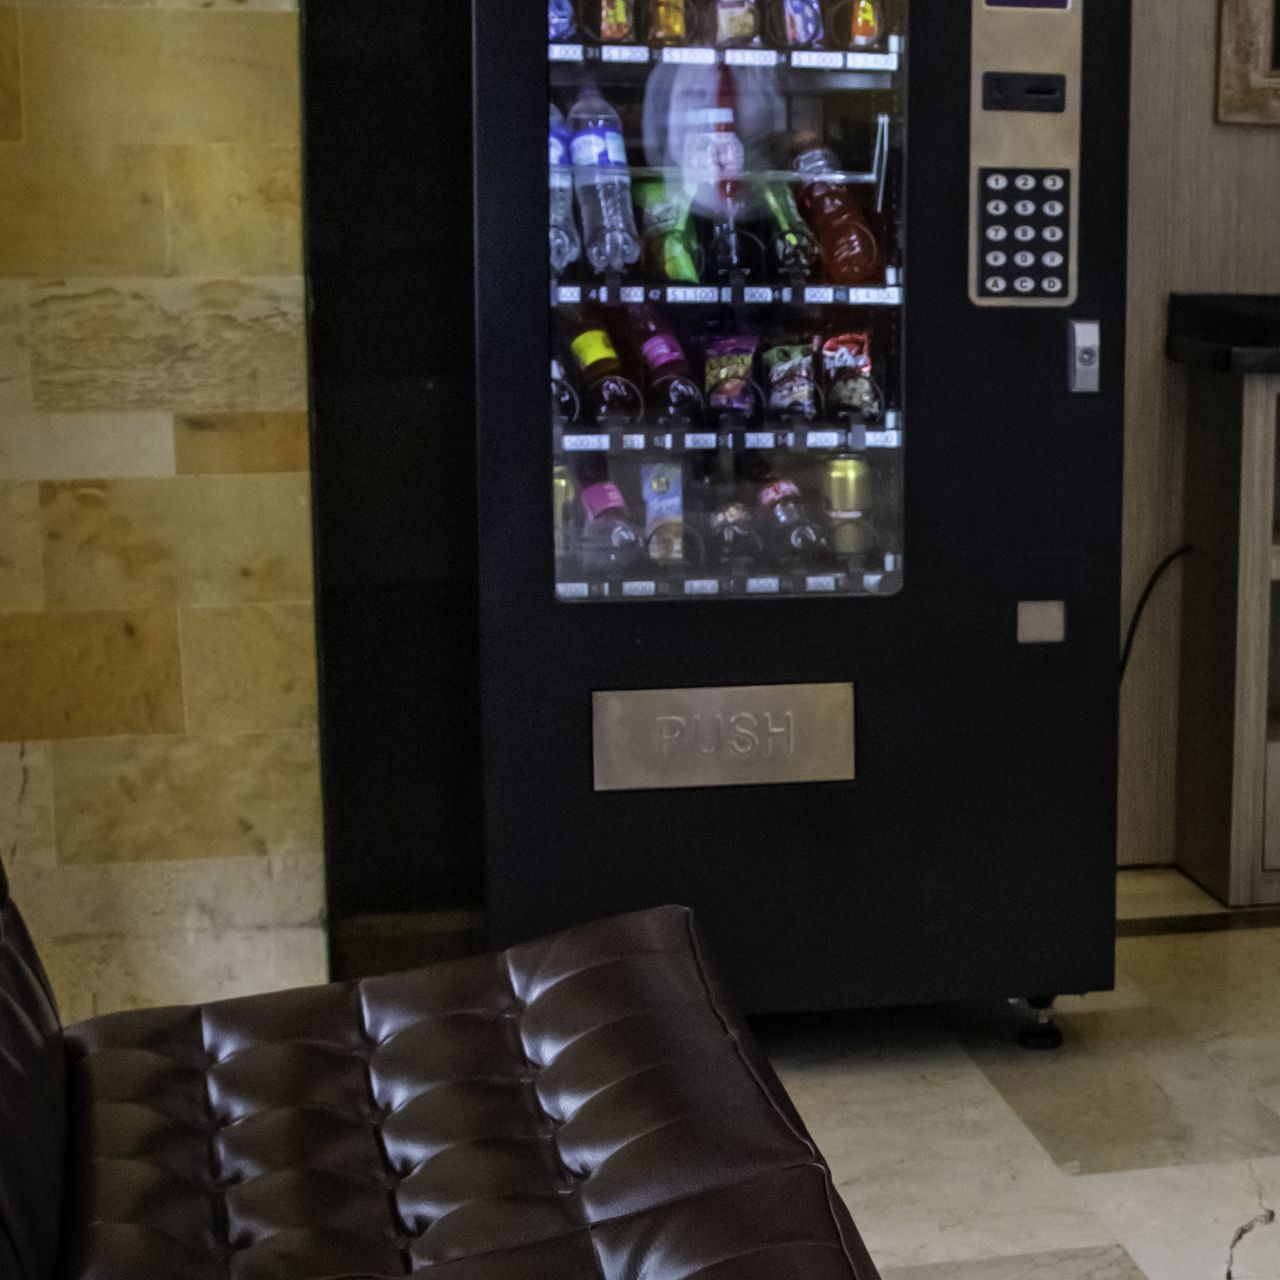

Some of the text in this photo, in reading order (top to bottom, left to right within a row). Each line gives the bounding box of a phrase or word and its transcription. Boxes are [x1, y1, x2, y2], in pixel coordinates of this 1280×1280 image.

[1021, 177, 1028, 187] 2
[1049, 177, 1056, 187] 3
[992, 202, 1056, 212] 4 5 6
[992, 228, 1000, 237] 7
[1049, 228, 1056, 238] 9
[991, 279, 1000, 289] A
[1020, 280, 1028, 289] C
[656, 711, 794, 757] PUSH
